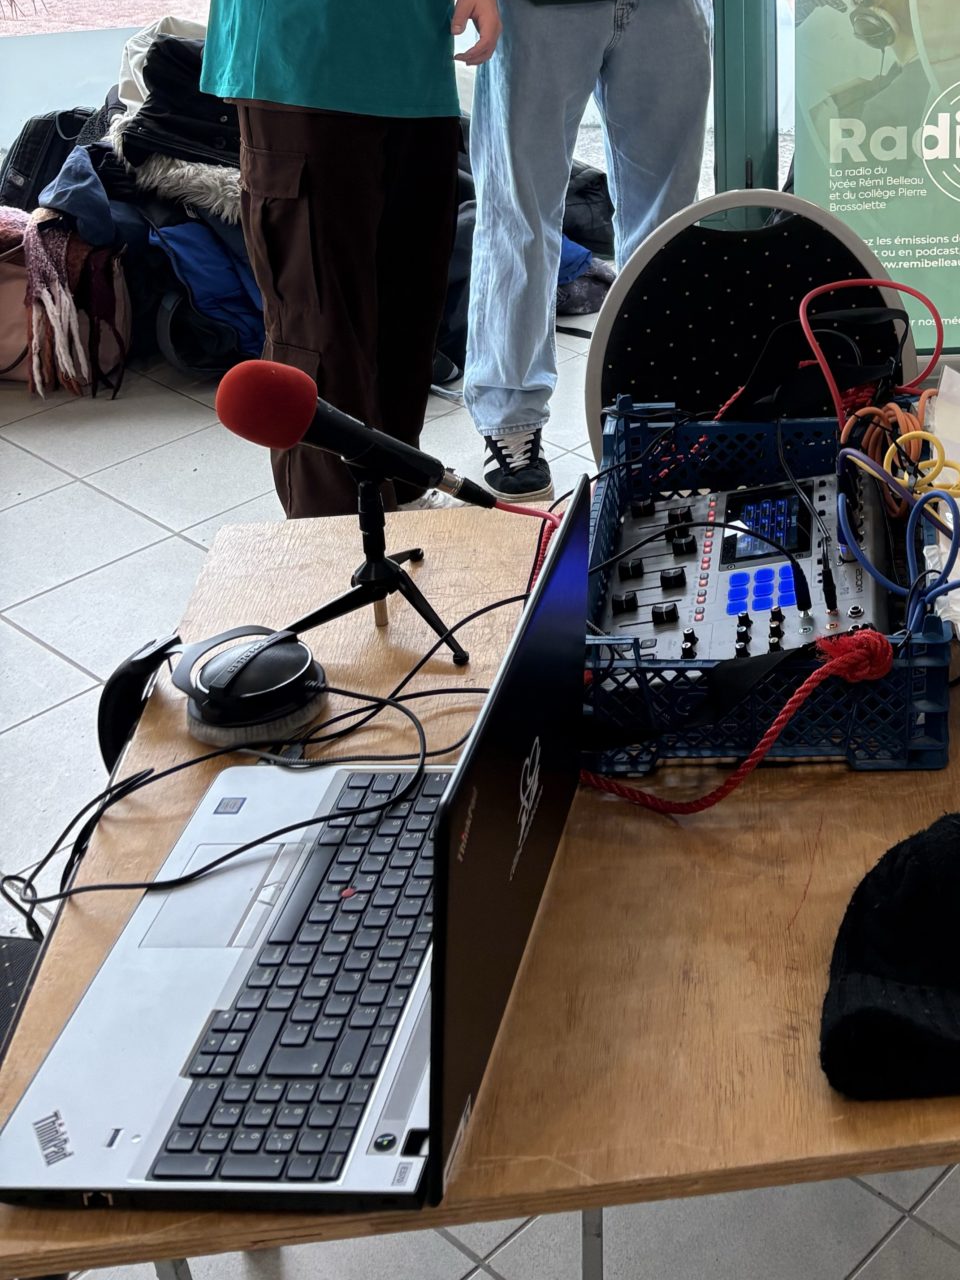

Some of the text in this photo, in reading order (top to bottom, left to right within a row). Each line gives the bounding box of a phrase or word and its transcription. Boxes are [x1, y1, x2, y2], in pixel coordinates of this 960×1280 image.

[830, 165, 888, 177] La radio du
[830, 176, 924, 190] lycée Rémi Belleau
[830, 188, 927, 200] et du collège Pierre
[830, 201, 887, 212] Brossolette
[876, 236, 892, 246] les
[894, 235, 950, 244] émissions
[898, 249, 912, 257] en
[918, 318, 937, 327] nos
[32, 1110, 74, 1166] ThinkPad
